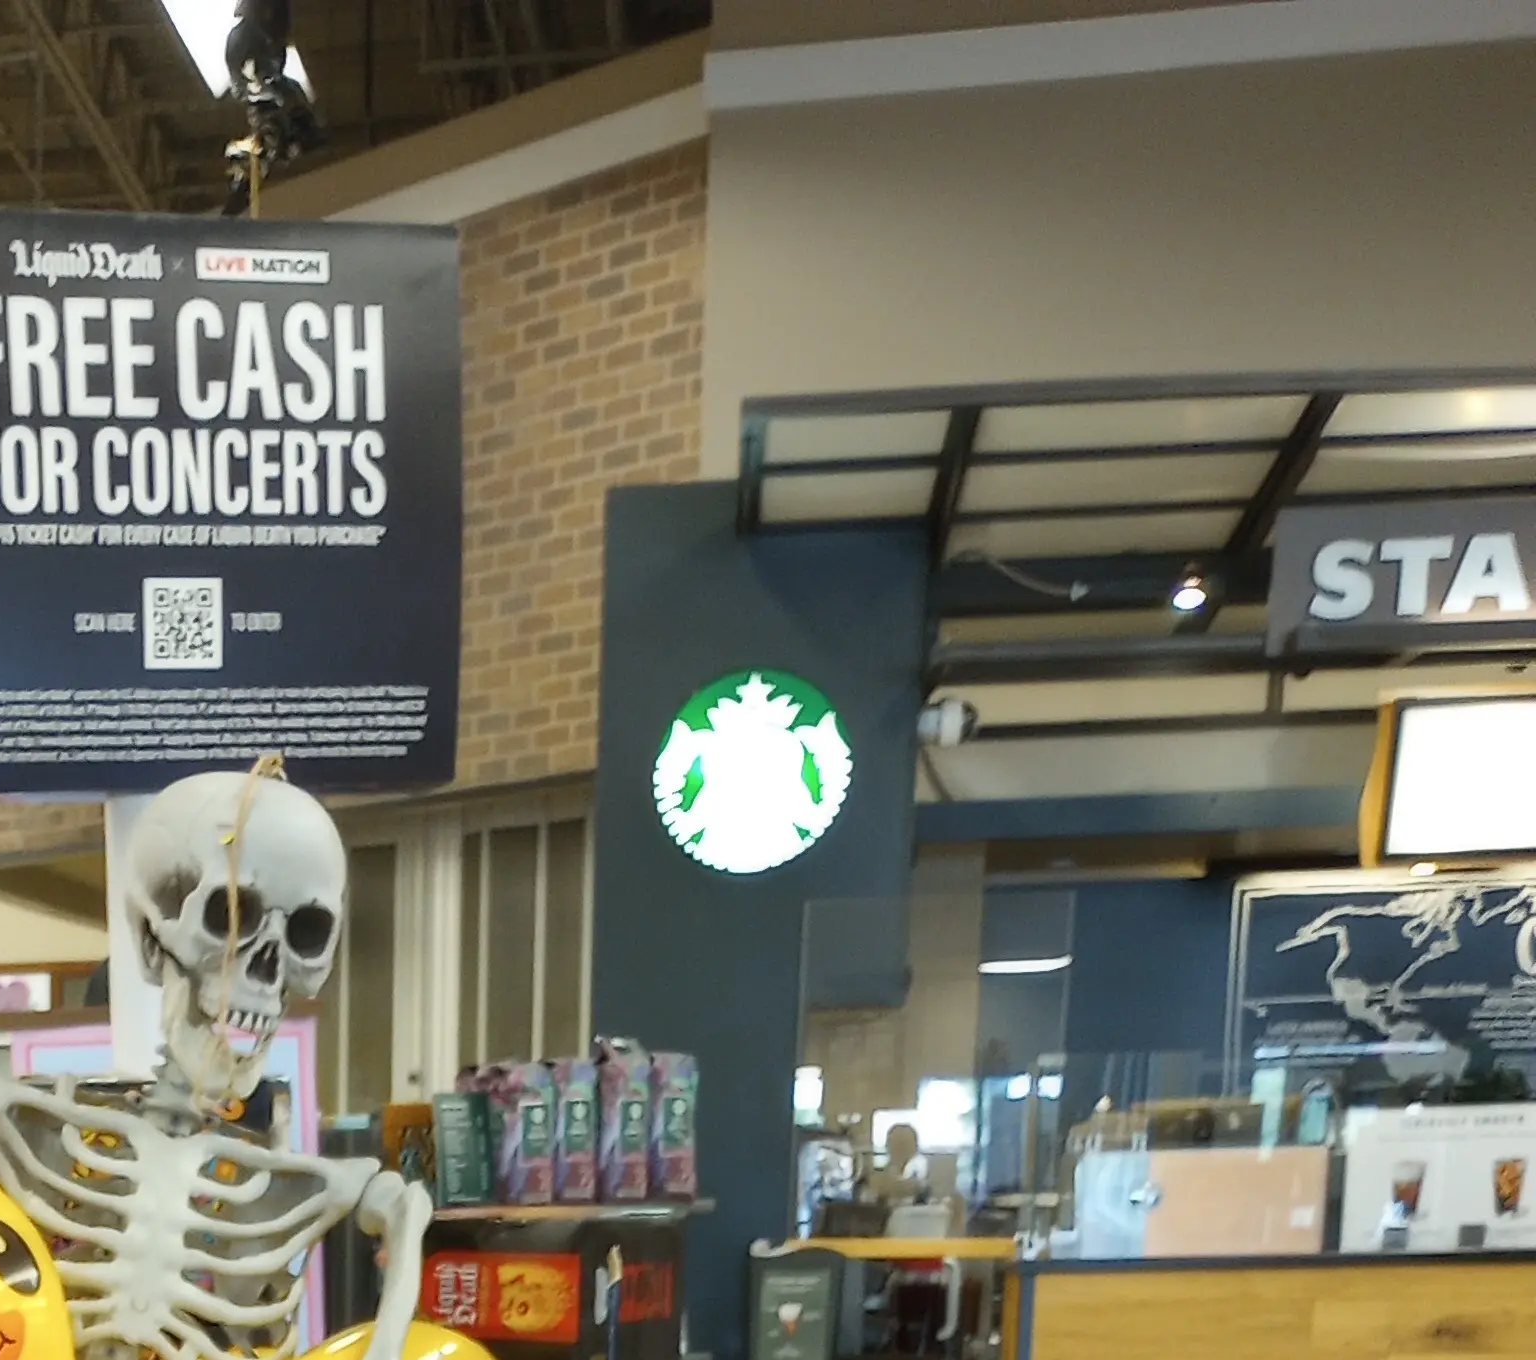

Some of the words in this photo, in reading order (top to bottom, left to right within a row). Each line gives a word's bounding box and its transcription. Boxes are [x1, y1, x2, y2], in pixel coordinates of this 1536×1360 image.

[9, 239, 91, 288] Liquid
[90, 243, 163, 284] Death
[205, 254, 247, 275] LIVE
[251, 257, 322, 275] NATION
[176, 297, 388, 422] CASH
[93, 427, 388, 517] CONCERTS
[1310, 532, 1536, 622] STA
